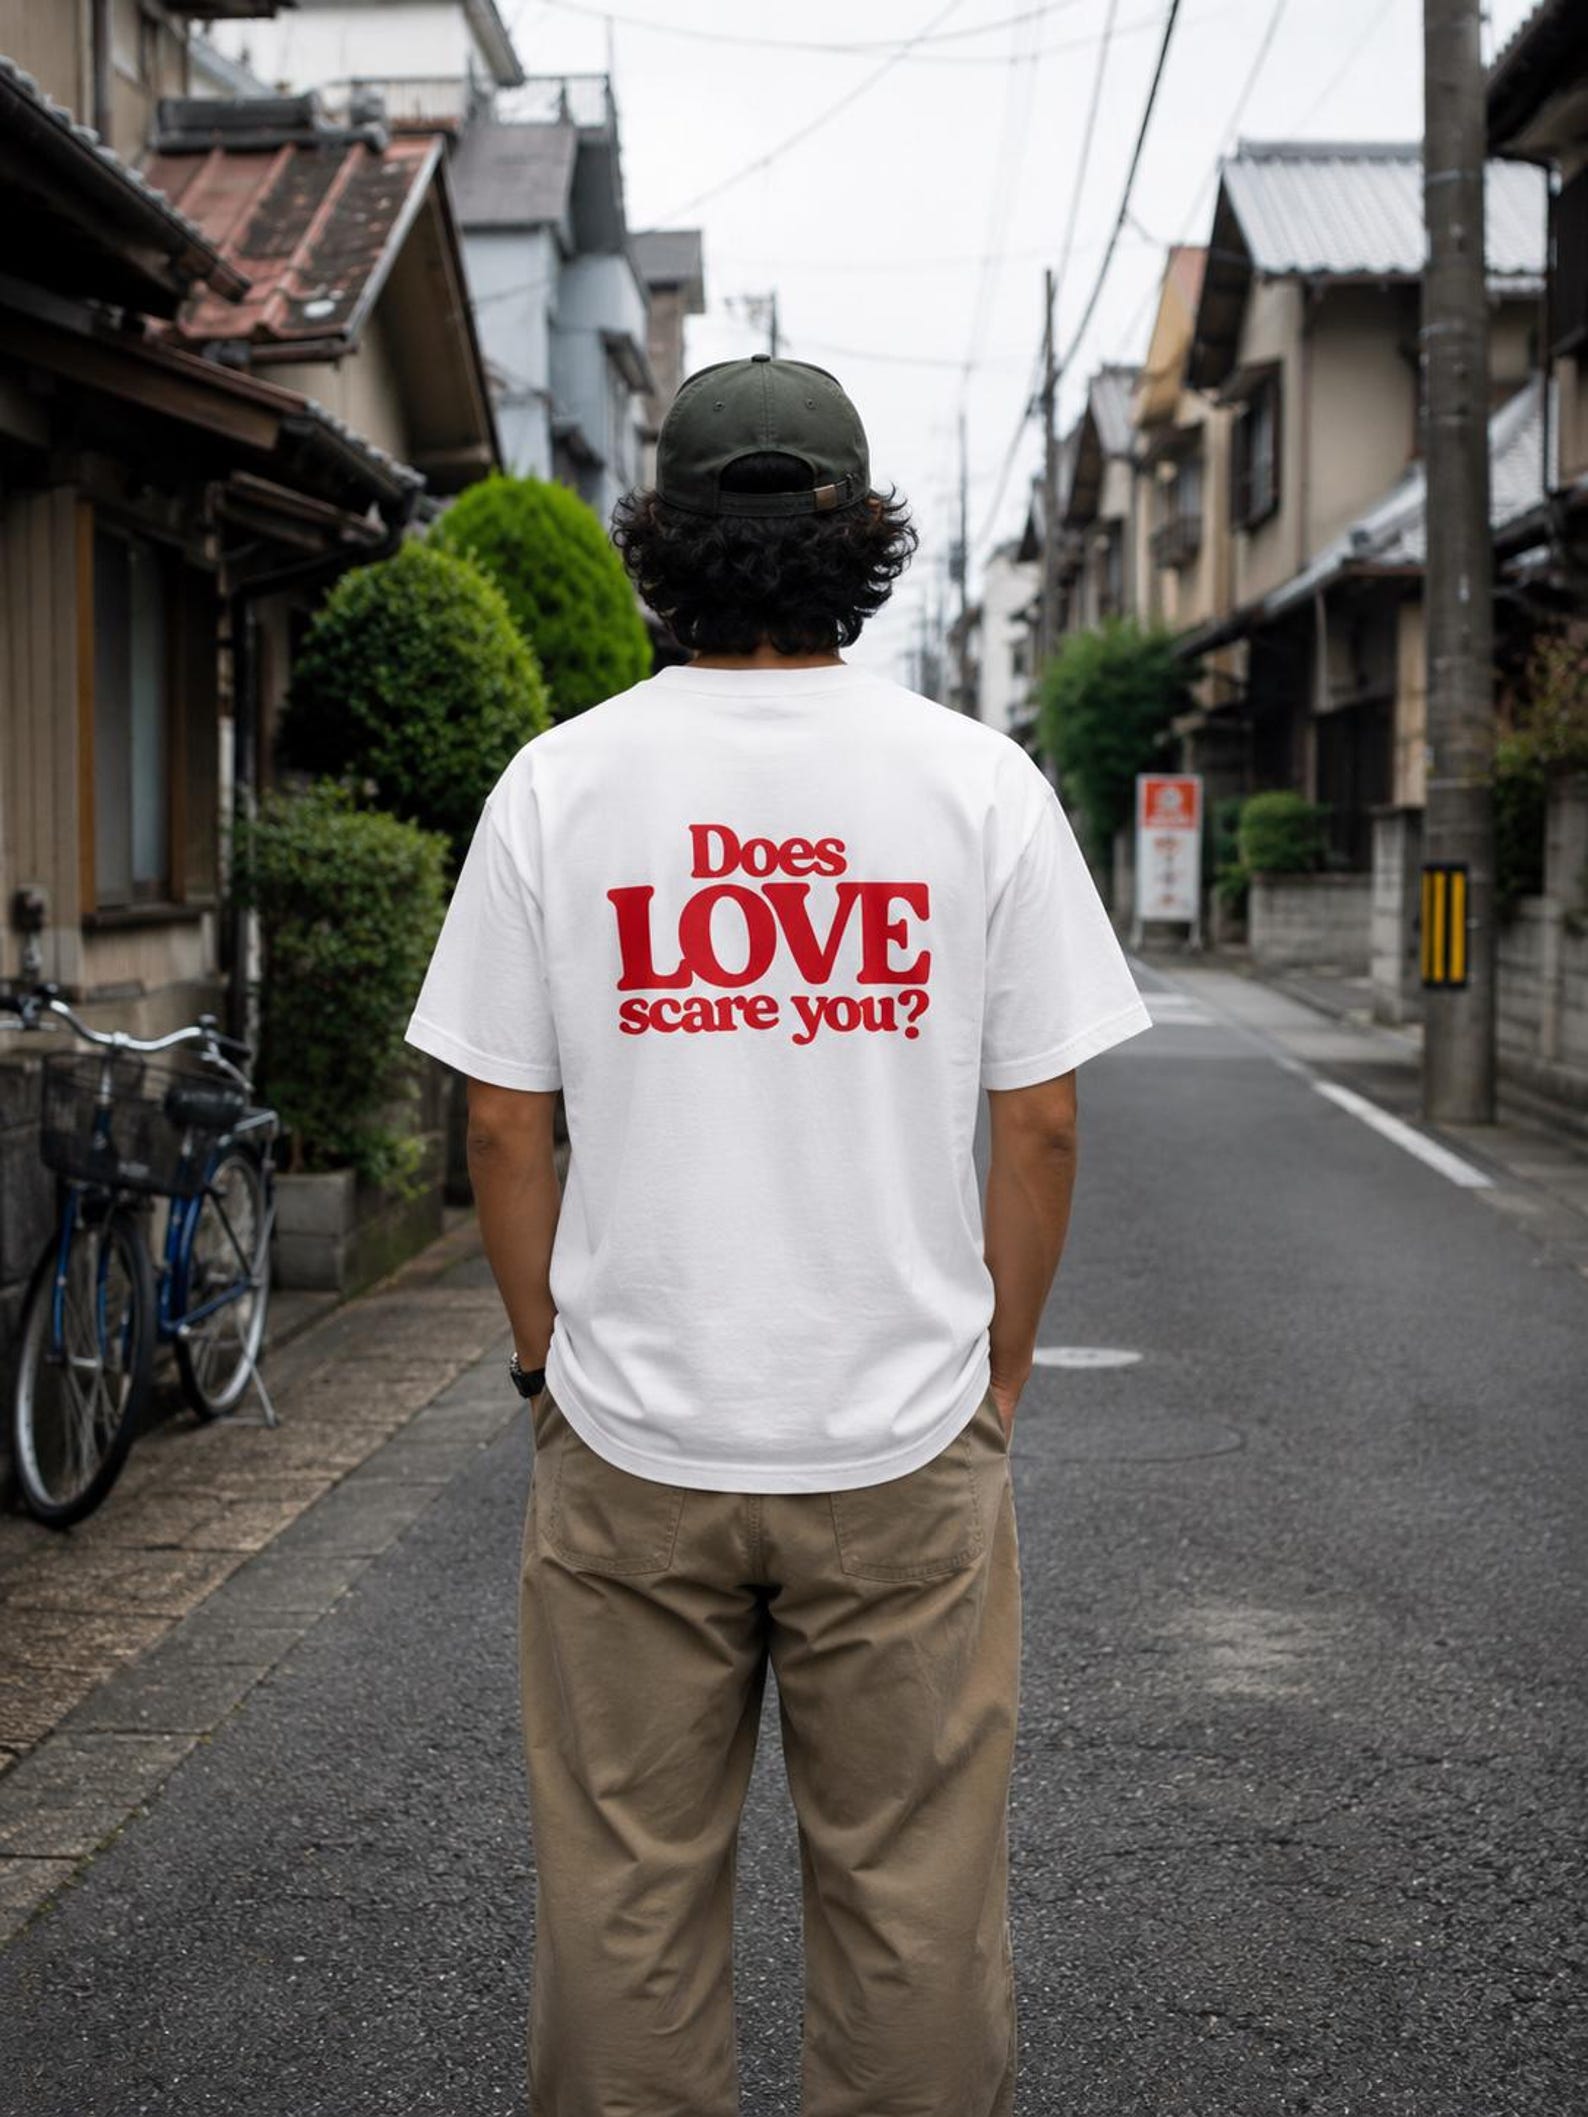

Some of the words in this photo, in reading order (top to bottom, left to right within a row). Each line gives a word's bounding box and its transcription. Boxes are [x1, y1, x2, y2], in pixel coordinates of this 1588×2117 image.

[688, 823, 849, 880] Does
[607, 881, 932, 993] LOVE
[618, 994, 780, 1036] scare
[790, 987, 931, 1047] you?
